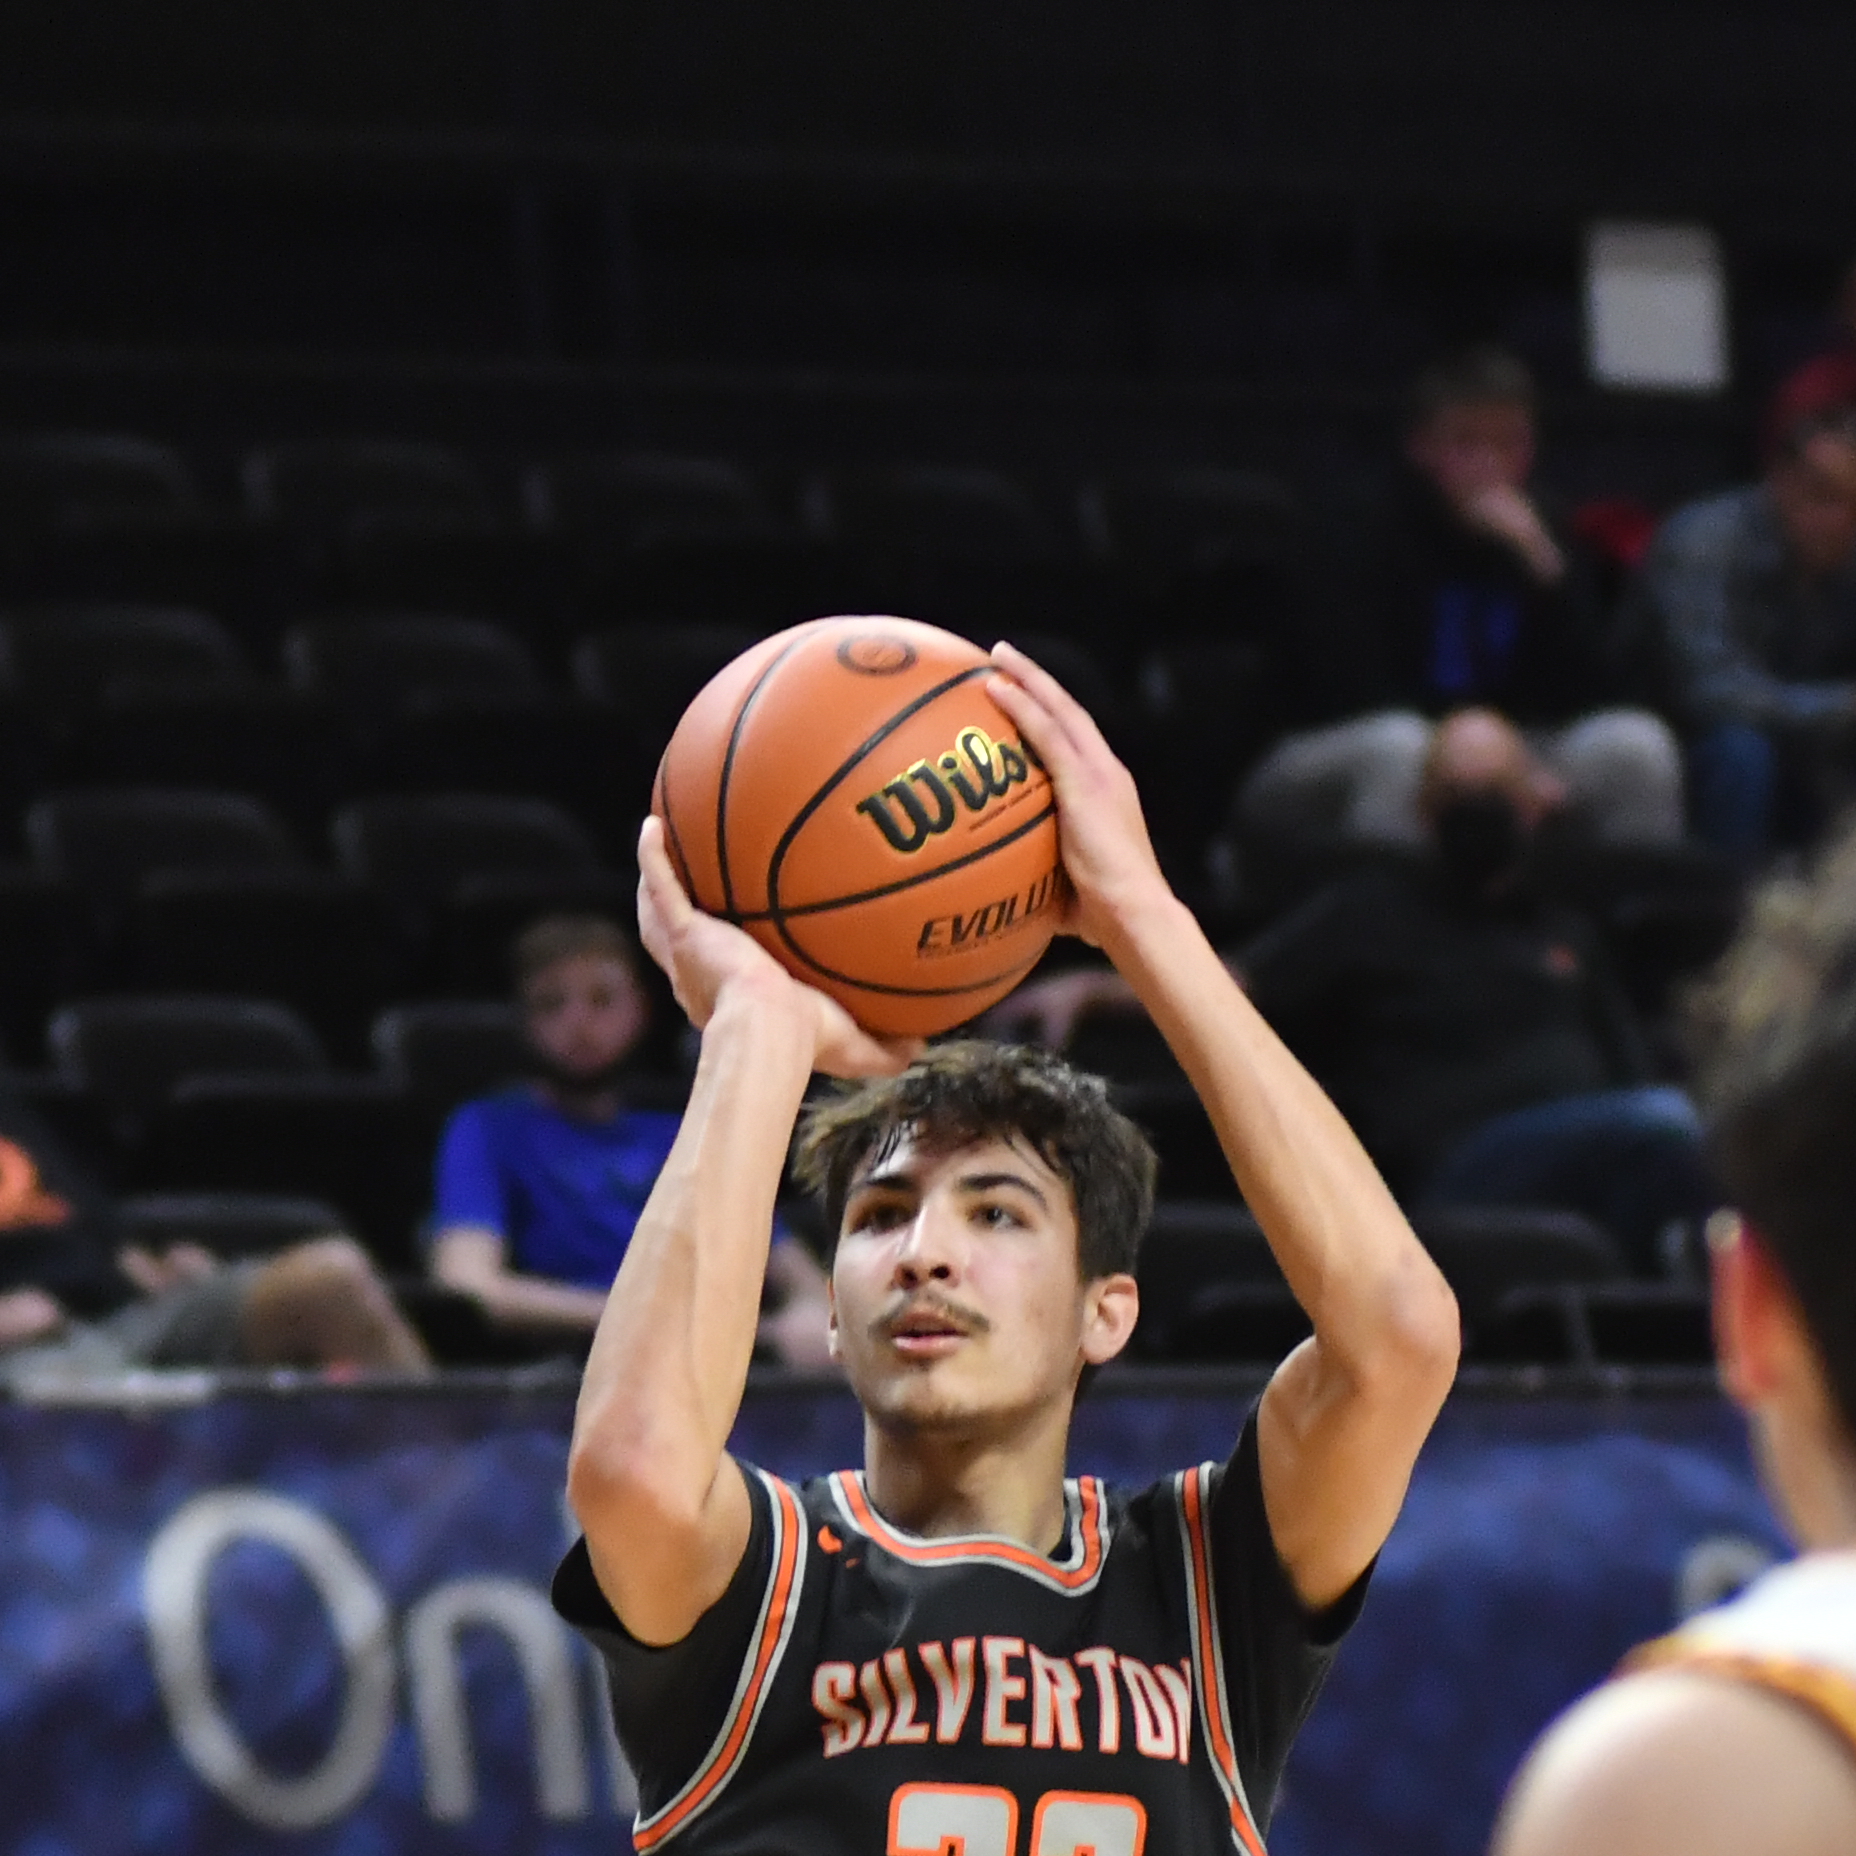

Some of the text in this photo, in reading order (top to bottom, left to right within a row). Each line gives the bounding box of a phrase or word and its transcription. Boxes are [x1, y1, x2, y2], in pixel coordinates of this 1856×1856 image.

[855, 726, 1028, 853] Wils
[917, 866, 1058, 952] EVOLU
[142, 1485, 640, 1834] On
